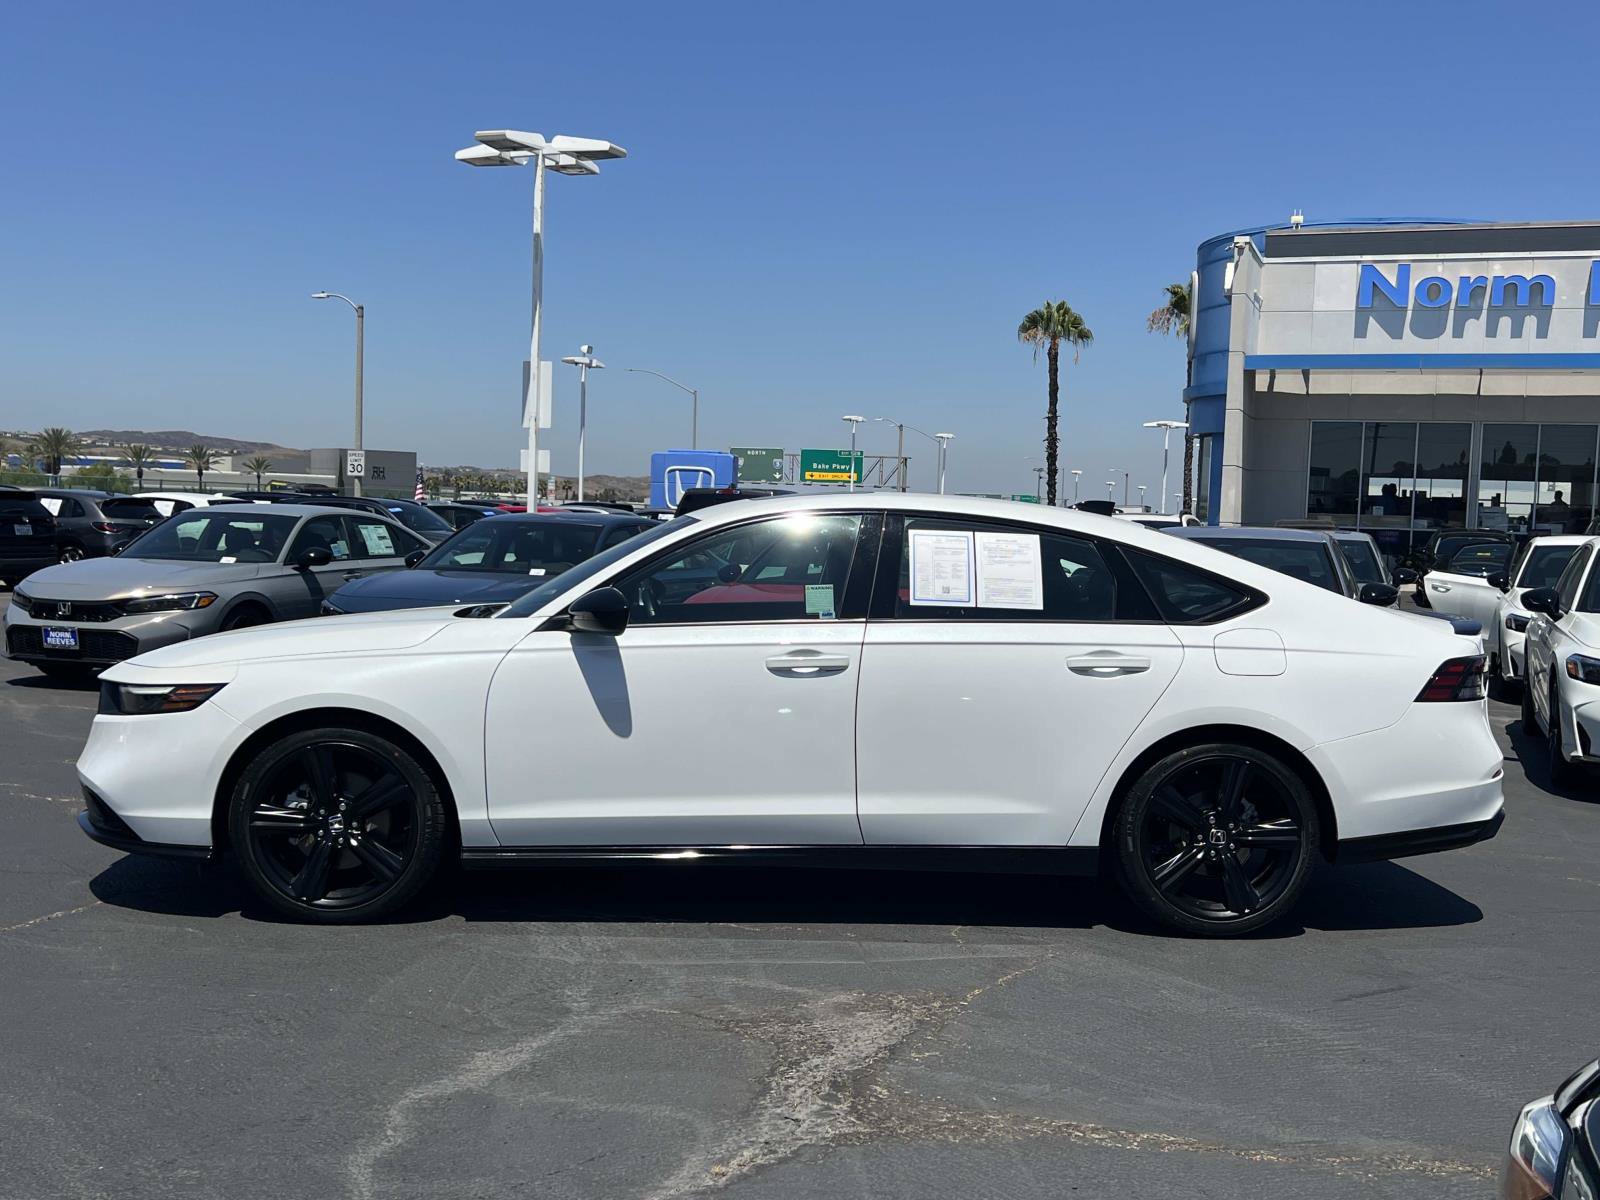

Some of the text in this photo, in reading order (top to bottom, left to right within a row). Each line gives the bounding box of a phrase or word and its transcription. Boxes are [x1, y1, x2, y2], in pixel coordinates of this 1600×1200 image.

[1358, 263, 1556, 308] Norm
[349, 463, 363, 473] 30
[47, 638, 75, 646] REEVES
